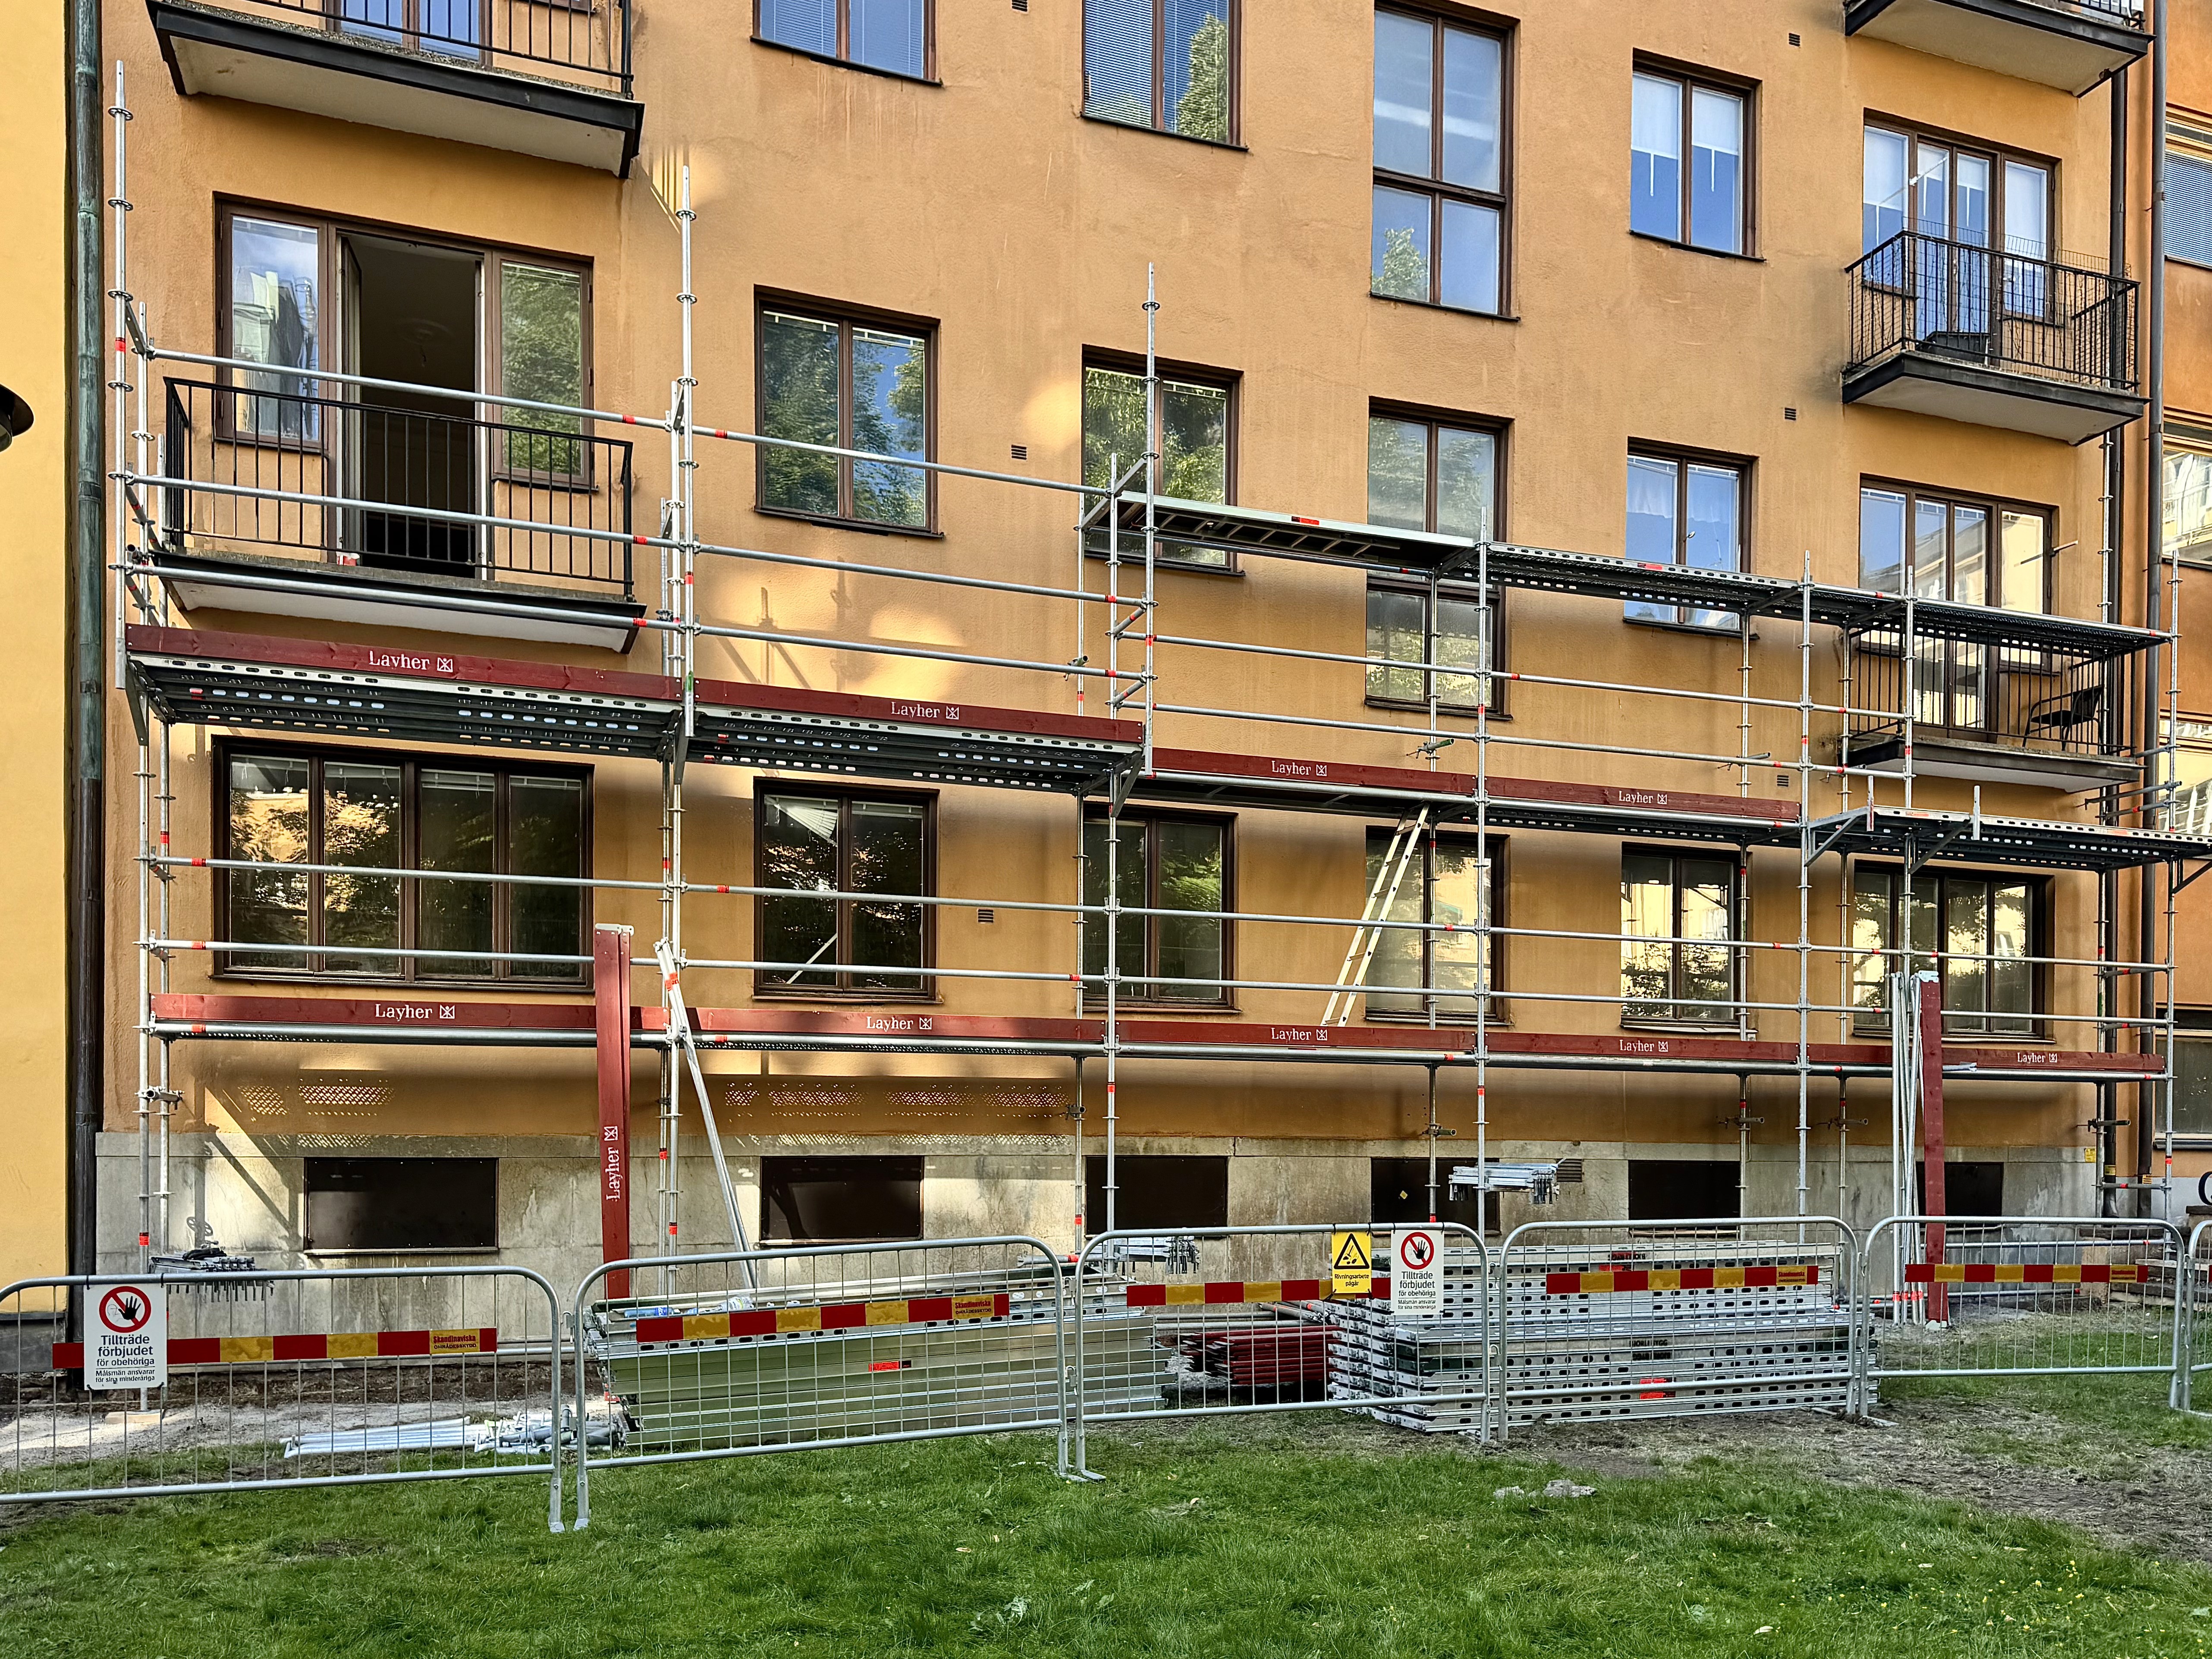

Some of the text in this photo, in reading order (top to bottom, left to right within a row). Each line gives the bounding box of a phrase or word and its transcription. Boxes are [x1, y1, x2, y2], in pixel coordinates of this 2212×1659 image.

[369, 651, 430, 669] Layher
[892, 702, 940, 719] Layher
[1272, 761, 1311, 776] Layher
[1619, 791, 1653, 804] Layher
[375, 1004, 433, 1021] Layher
[867, 1016, 914, 1032] Layher
[1271, 1028, 1311, 1043] Layher
[1620, 1040, 1654, 1053] Layher
[2017, 1053, 2045, 1063] Layher
[605, 1147, 623, 1200] Layher
[1401, 1271, 1433, 1279] Tillträde
[1400, 1280, 1435, 1290] förbjudet
[101, 1334, 150, 1345] Tillträde
[433, 1335, 476, 1344] Skandinaviska
[98, 1345, 153, 1358] förbjudet
[111, 1357, 154, 1366] obehöriga
